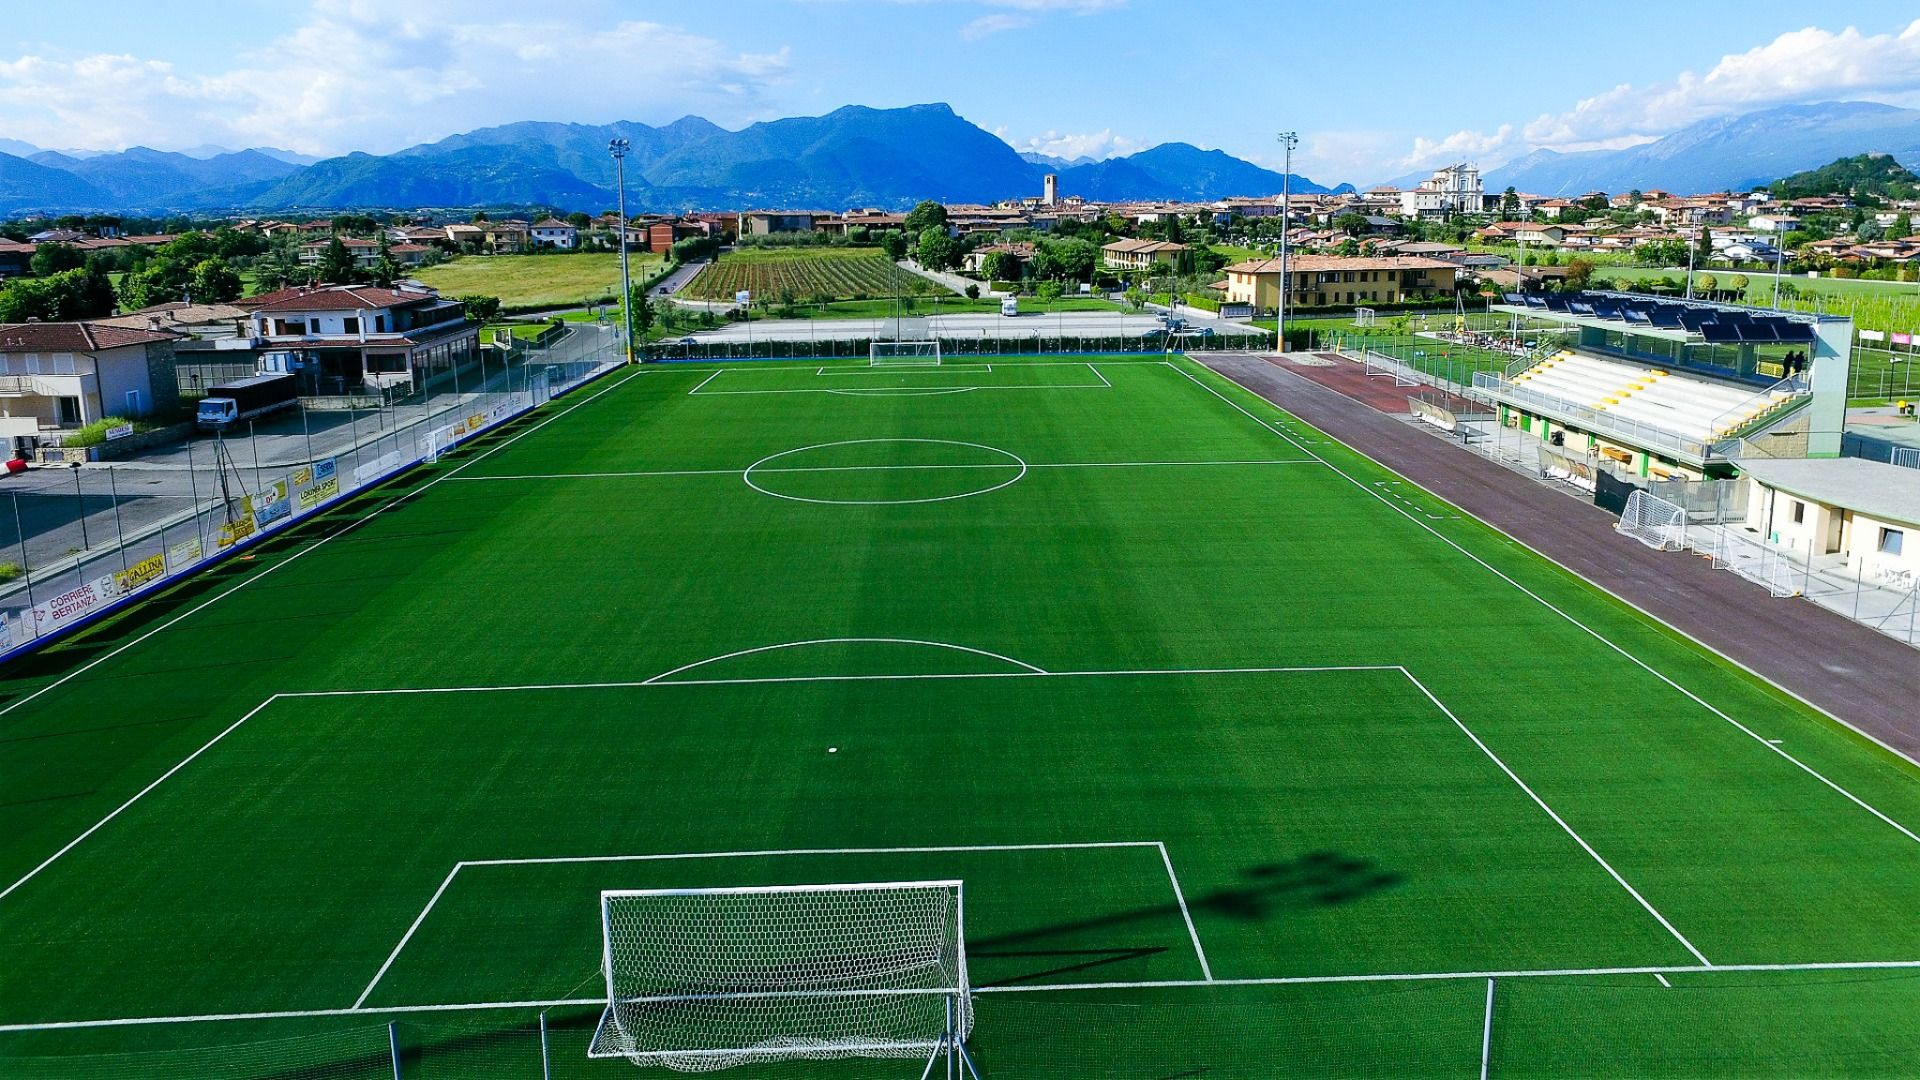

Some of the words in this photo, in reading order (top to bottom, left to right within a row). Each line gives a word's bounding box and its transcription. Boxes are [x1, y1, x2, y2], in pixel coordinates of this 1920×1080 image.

[129, 558, 163, 580] GALLINA
[50, 584, 94, 609] CORRIERE
[51, 594, 98, 620] BERTANZA
